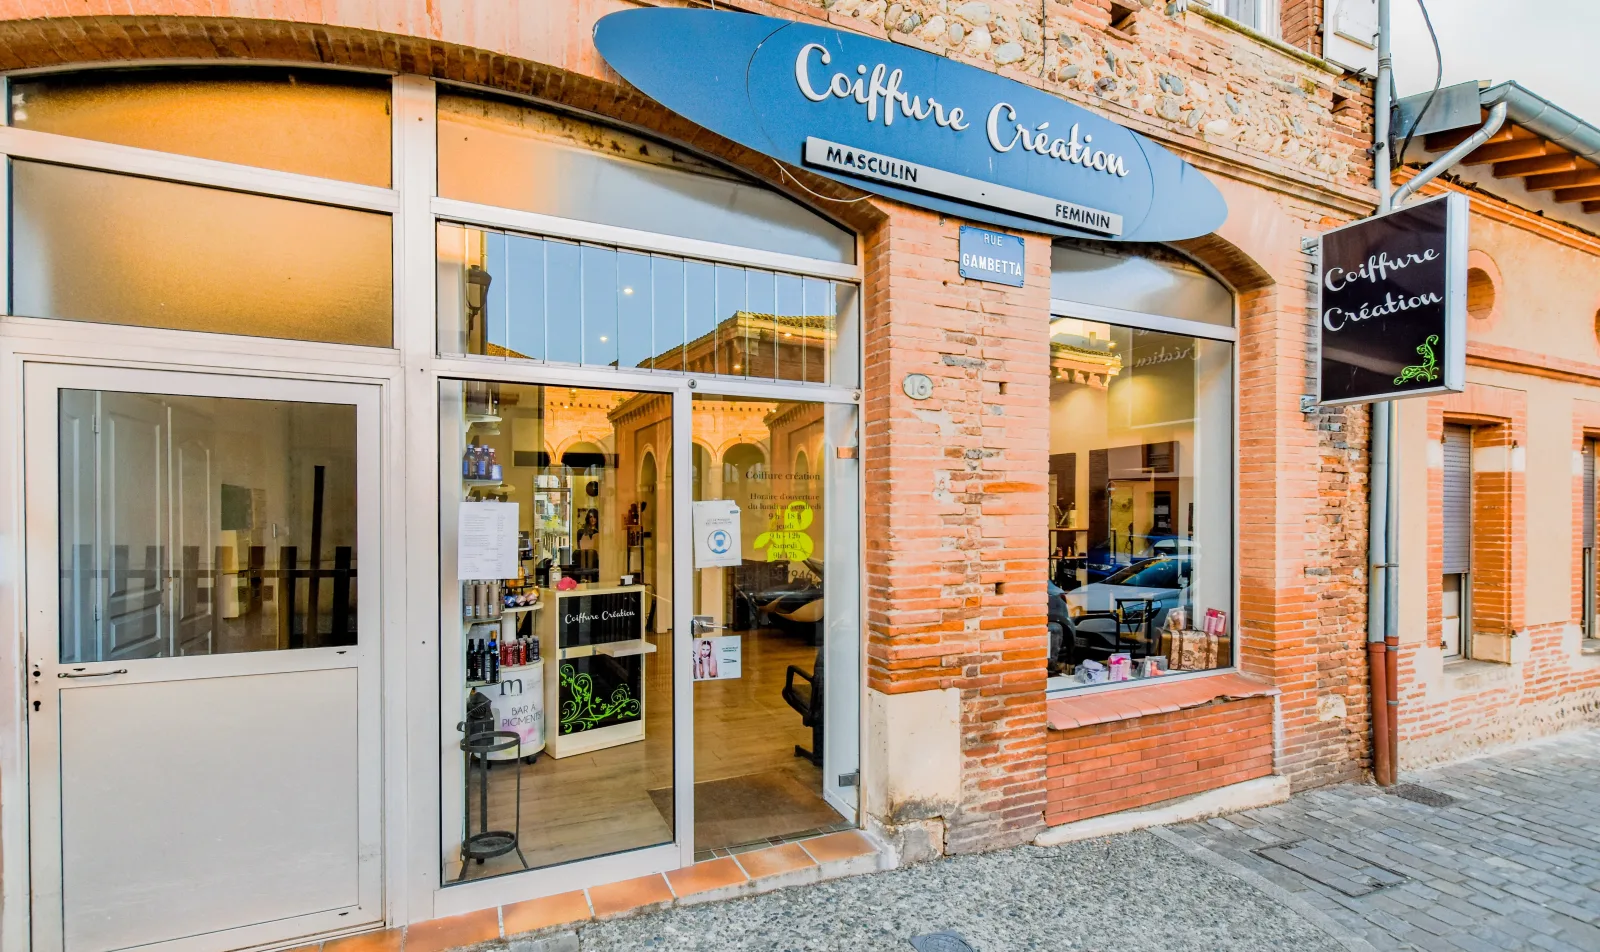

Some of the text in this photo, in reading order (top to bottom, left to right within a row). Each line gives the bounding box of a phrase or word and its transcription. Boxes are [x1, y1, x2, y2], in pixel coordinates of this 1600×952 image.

[795, 43, 1129, 177] Coiffure Création
[826, 146, 918, 182] MASCULIN
[1055, 203, 1111, 229] FEMININ
[983, 233, 1003, 247] RUE
[962, 253, 1022, 277] GAMBETTA
[1324, 248, 1441, 292] Coiffure
[1323, 291, 1443, 332] Création
[745, 471, 820, 480] Coiffure création
[776, 523, 794, 531] jeudi
[565, 609, 635, 624] Coiffure Création
[511, 705, 528, 716] BAR
